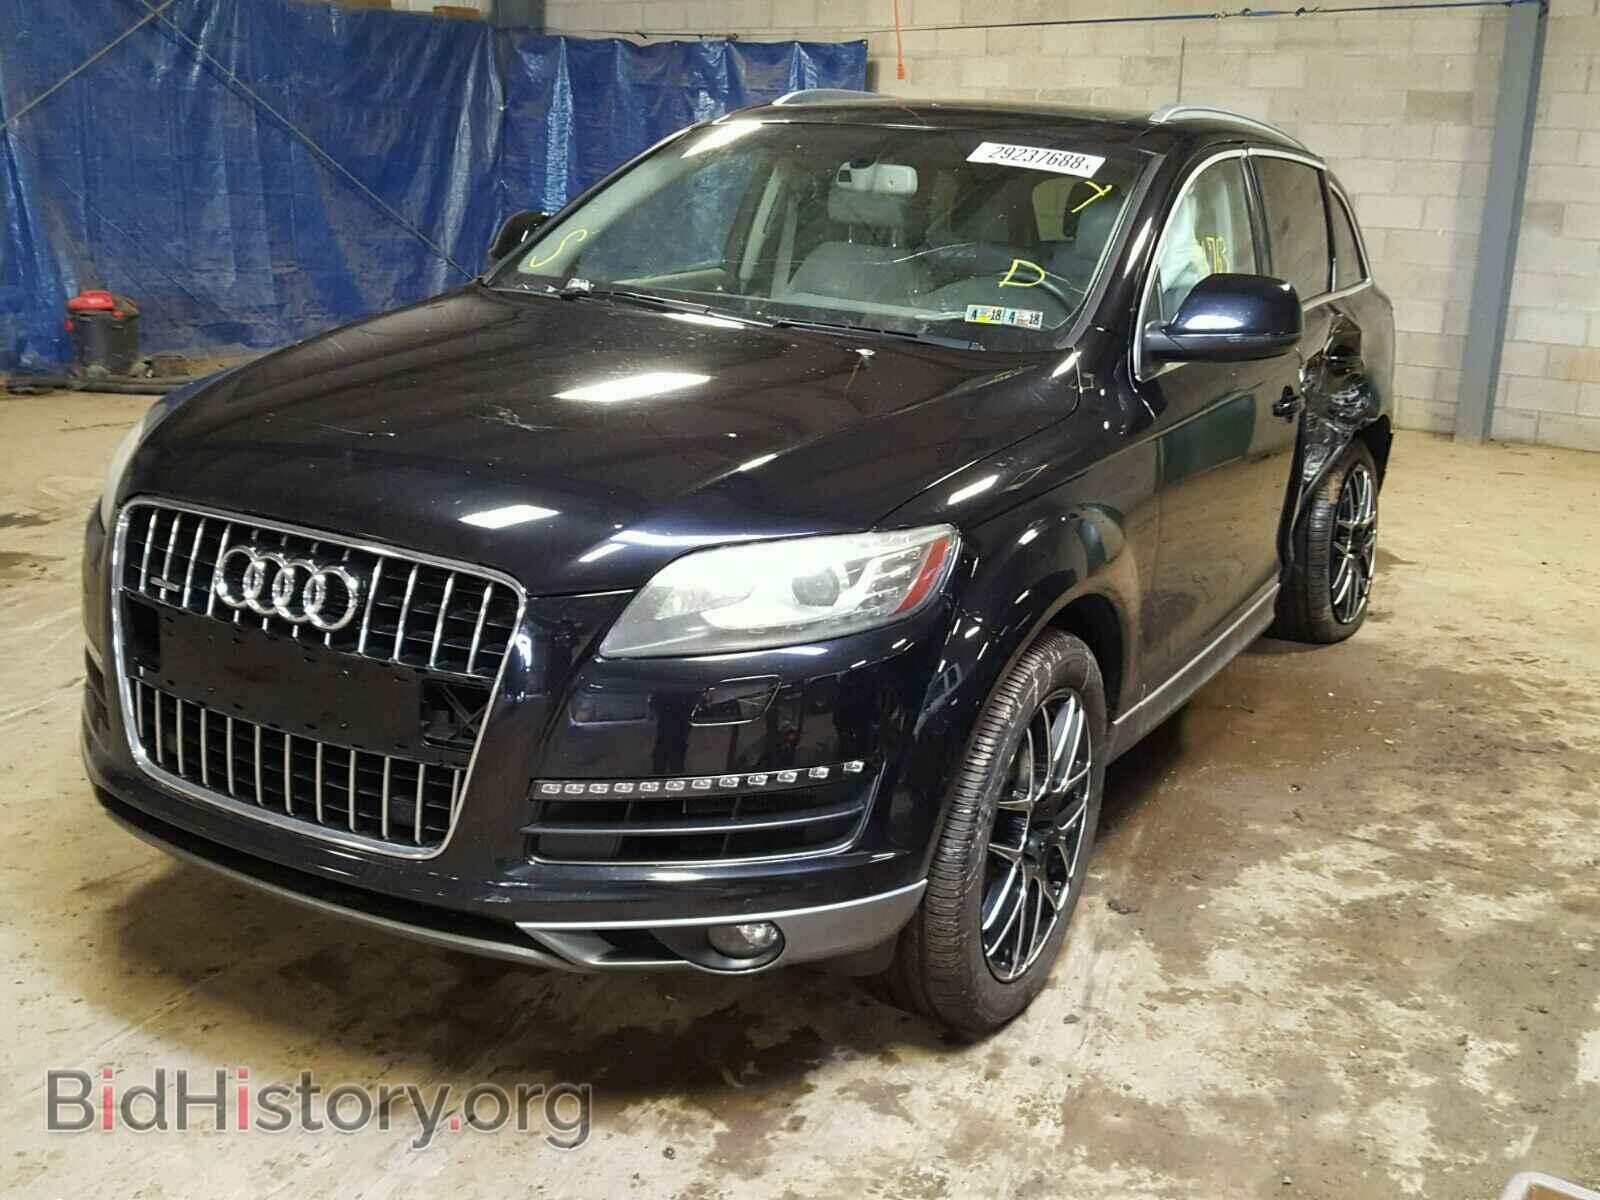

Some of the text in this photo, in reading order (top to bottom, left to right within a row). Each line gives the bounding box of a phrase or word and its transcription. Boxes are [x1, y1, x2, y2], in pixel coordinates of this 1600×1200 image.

[989, 146, 1085, 169] 29237688
[998, 259, 1046, 288] D
[1008, 311, 1041, 326] 4 18
